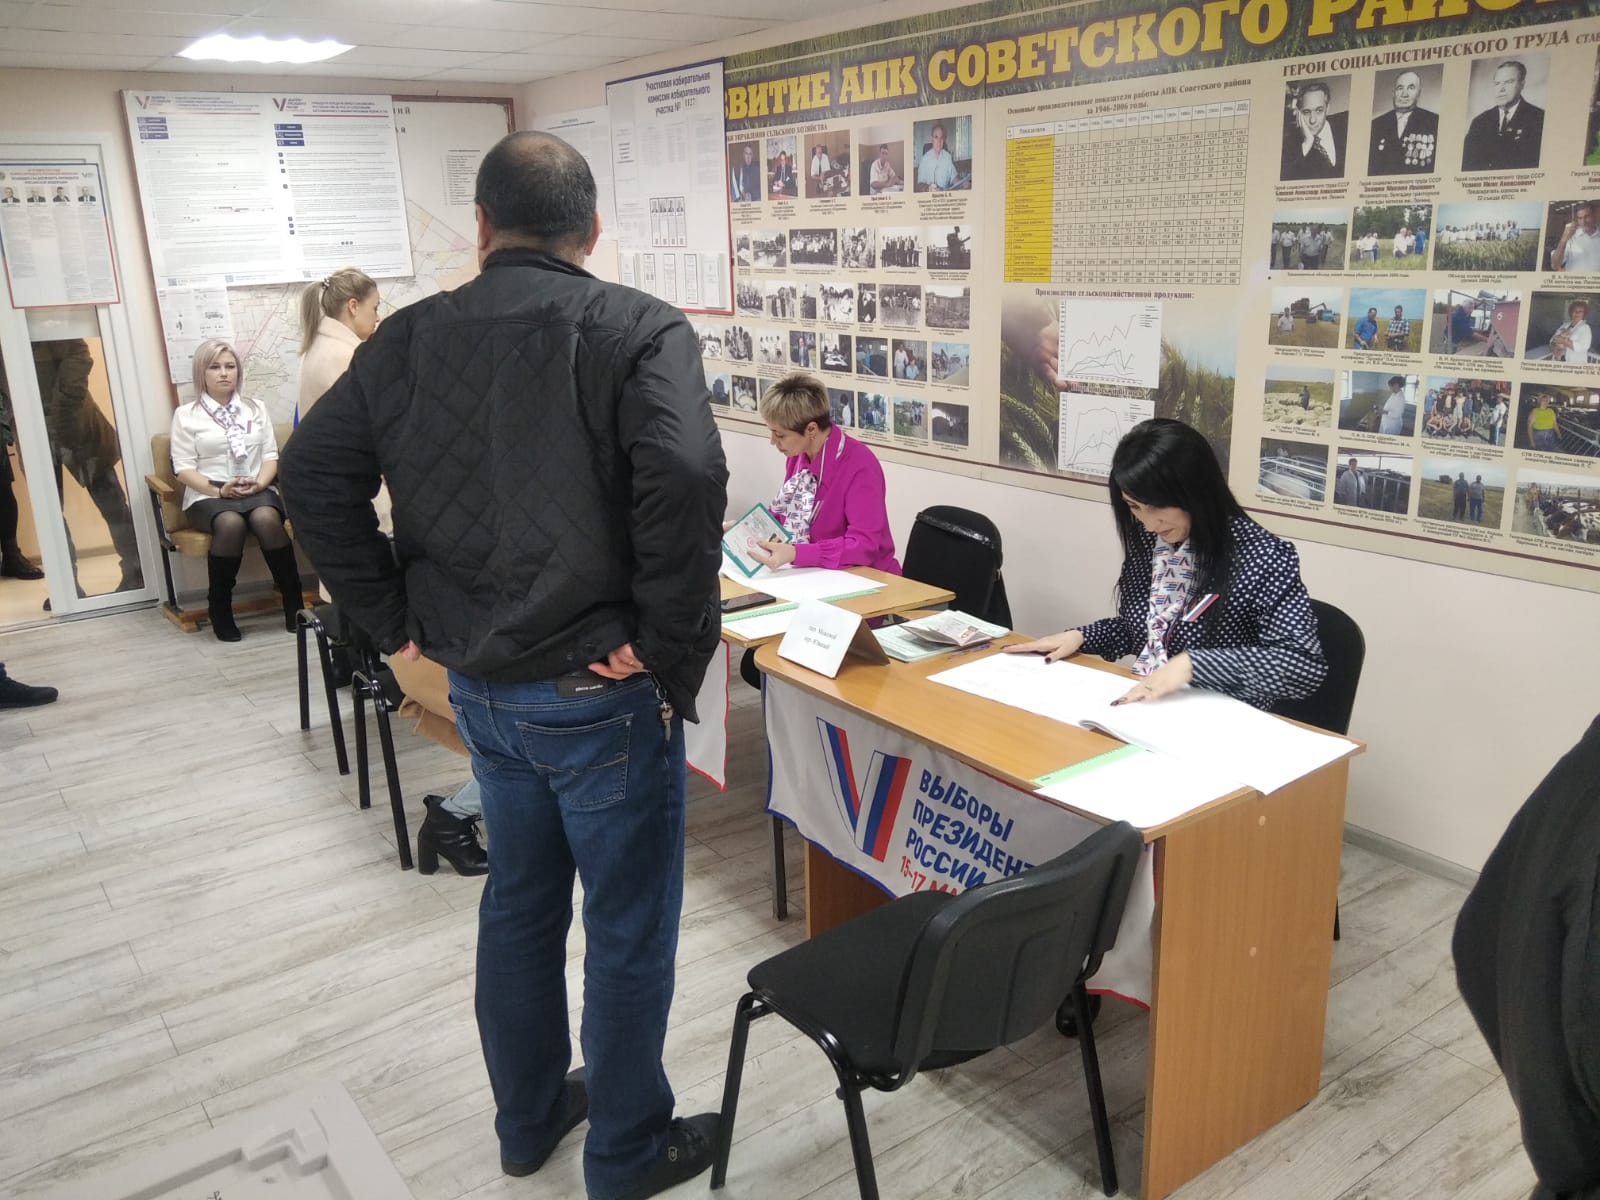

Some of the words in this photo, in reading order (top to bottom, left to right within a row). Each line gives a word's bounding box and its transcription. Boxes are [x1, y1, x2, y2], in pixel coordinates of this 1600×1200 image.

[839, 56, 918, 103] АПК
[928, 0, 1289, 91] СОВЕТСКОГО
[1282, 60, 1326, 78] ГЕРОИ
[1330, 36, 1508, 73] СОЦИАЛИСТИЧЕСКОГО
[1512, 29, 1570, 50] ТРУДА
[645, 78, 673, 92] Участковая
[673, 72, 711, 87] избирательная
[647, 92, 670, 104] комиссия
[671, 86, 711, 99] избирательного
[1007, 105, 1036, 115] Основные
[1037, 98, 1094, 112] производственные
[1095, 93, 1132, 105] показатели
[1133, 89, 1159, 101] работы
[1160, 86, 1177, 97] АПК
[1179, 82, 1222, 94] Советского
[1223, 78, 1252, 89] района
[655, 104, 674, 118] участка
[1078, 288, 1152, 300] сельскохозяйственной
[919, 768, 1014, 842] ВЫБОРЫ
[906, 827, 987, 890] РОССИИ
